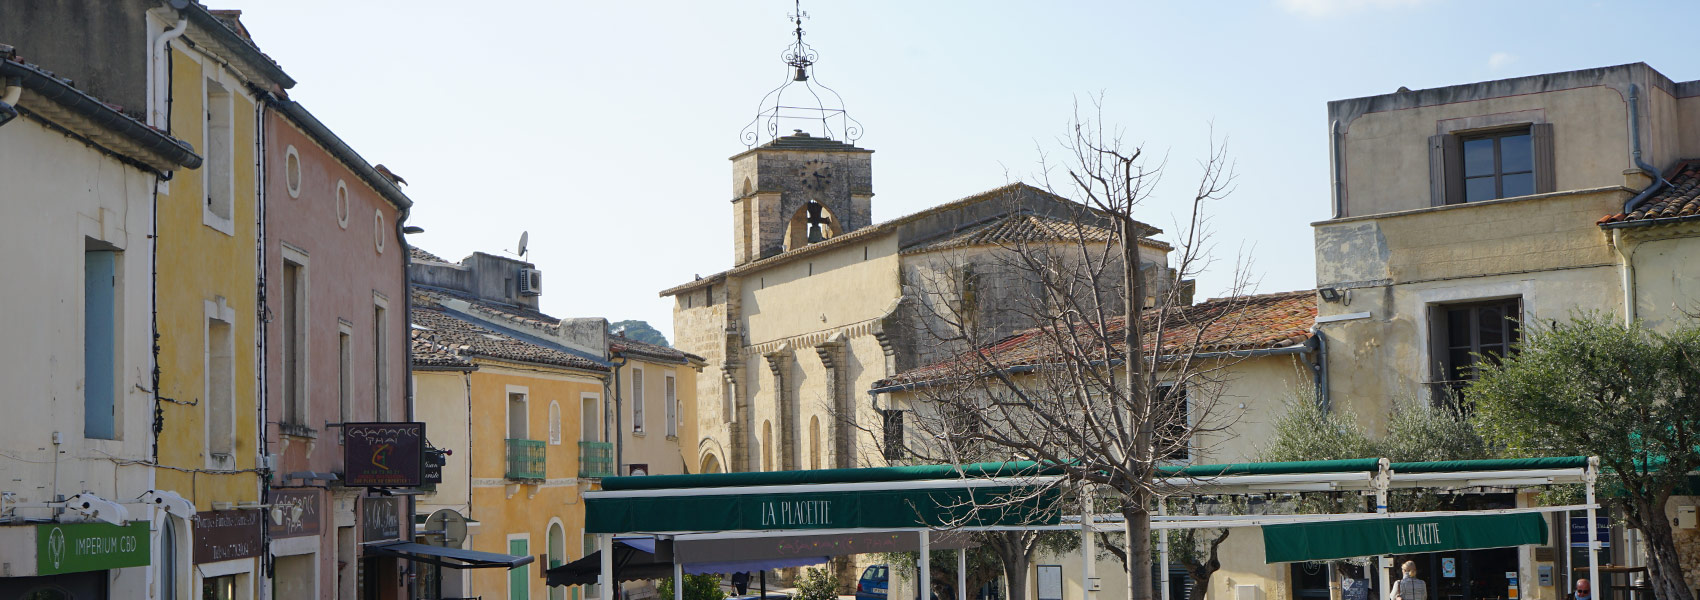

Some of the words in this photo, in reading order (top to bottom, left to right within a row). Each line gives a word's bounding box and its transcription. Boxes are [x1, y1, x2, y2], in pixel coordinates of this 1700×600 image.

[761, 501, 776, 526] LA
[781, 500, 833, 525] PLACETTE
[75, 537, 117, 555] IMPERIUM
[120, 535, 137, 553] CBD
[1396, 524, 1407, 547] LA
[1408, 522, 1442, 546] PLACETTE
